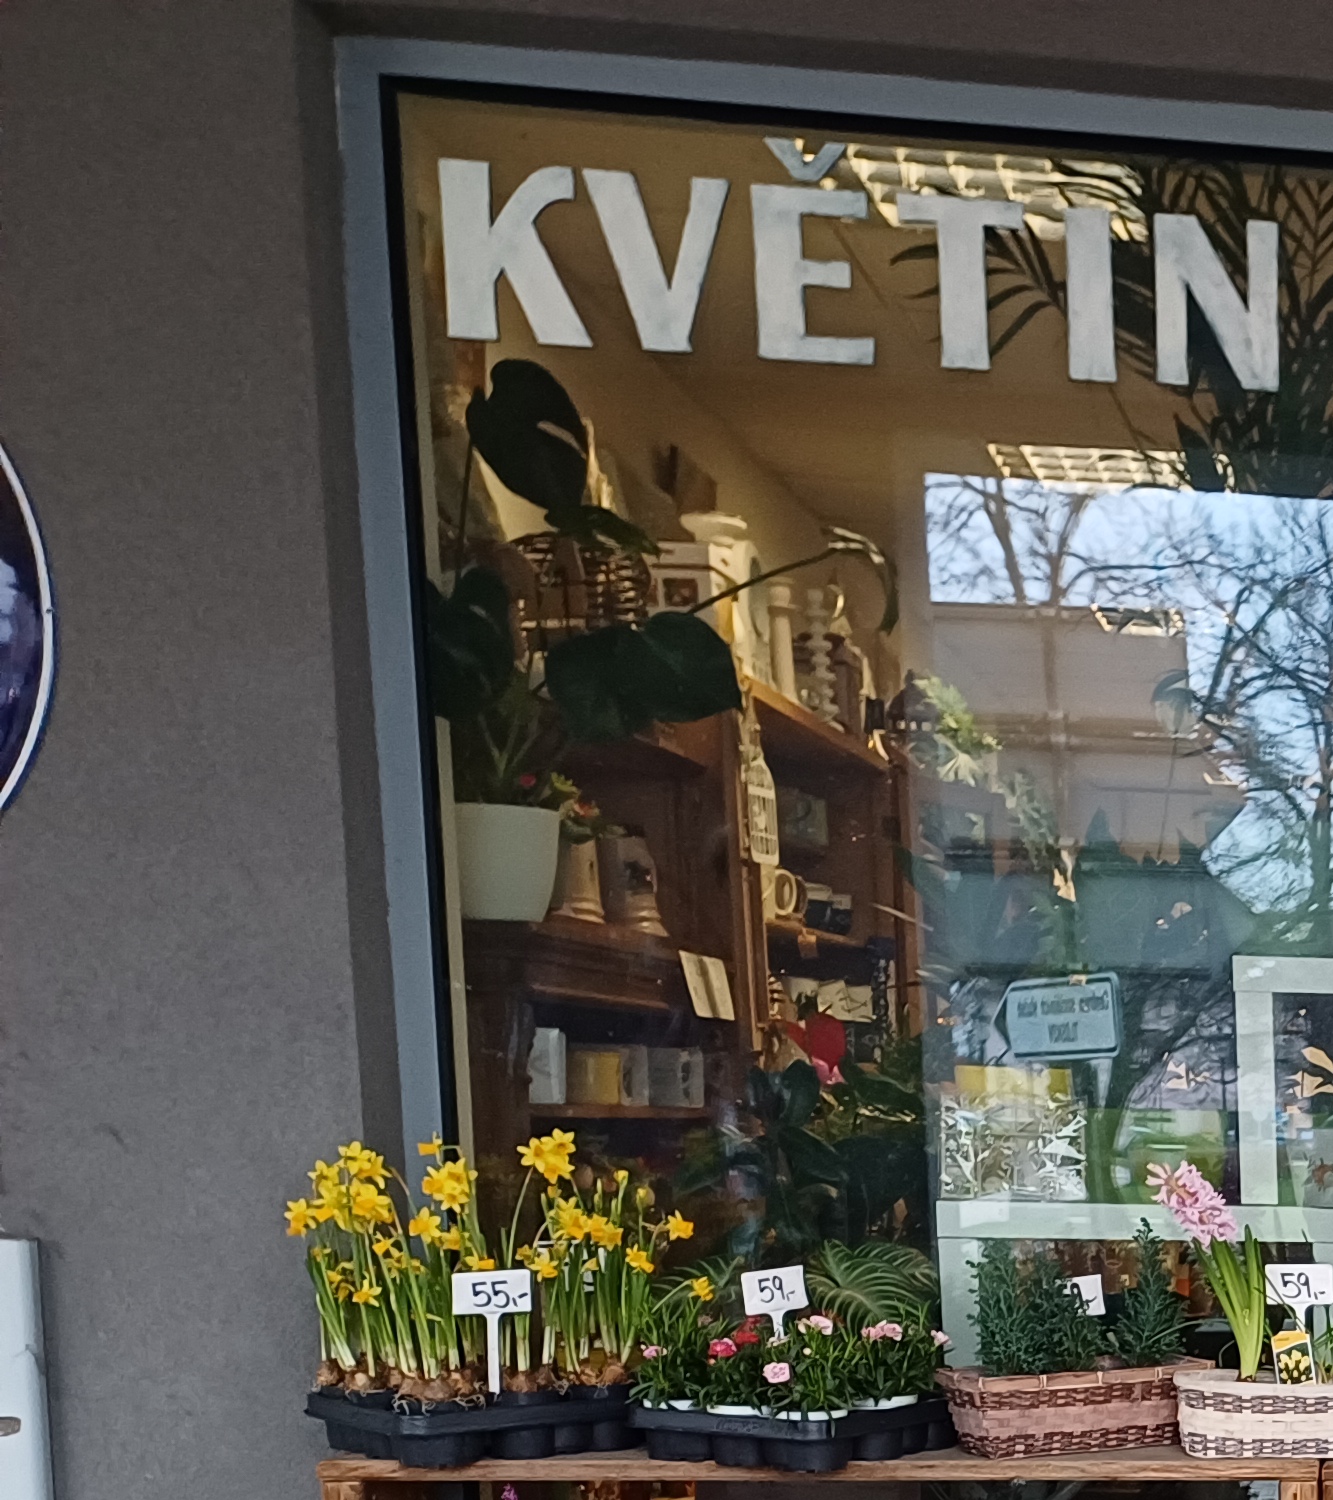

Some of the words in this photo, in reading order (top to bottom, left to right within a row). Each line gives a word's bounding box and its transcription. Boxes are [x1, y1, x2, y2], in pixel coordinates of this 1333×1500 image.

[437, 137, 1279, 392] KVĚTIN
[472, 1280, 528, 1308] 55,-
[757, 1275, 795, 1303] 59,-
[1280, 1272, 1326, 1300] 59,-
